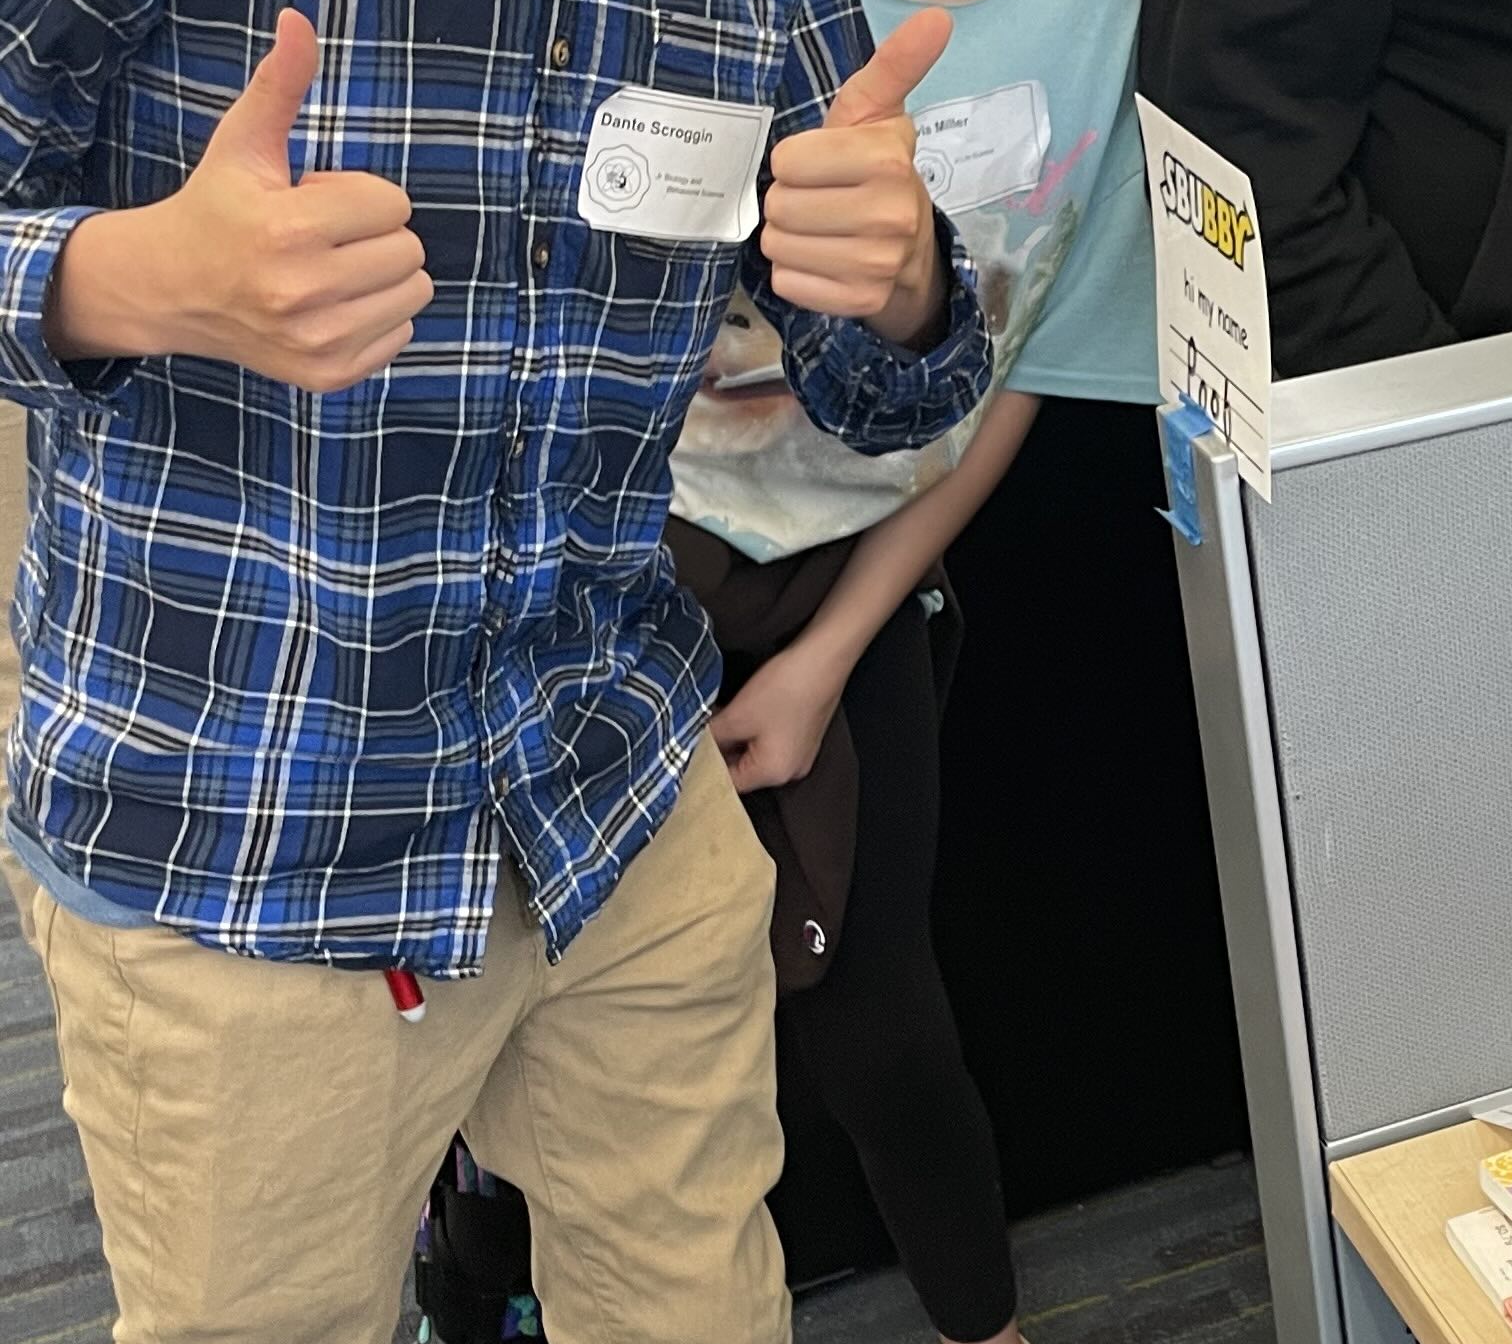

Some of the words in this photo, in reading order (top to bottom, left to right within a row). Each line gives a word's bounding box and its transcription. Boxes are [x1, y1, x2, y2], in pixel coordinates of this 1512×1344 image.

[600, 112, 646, 133] Dante
[651, 121, 713, 145] Scroggin
[935, 117, 969, 132] Miller
[1159, 150, 1256, 271] SBUBBY
[1184, 267, 1195, 303] hi
[1198, 288, 1214, 327] my
[1218, 305, 1249, 350] name
